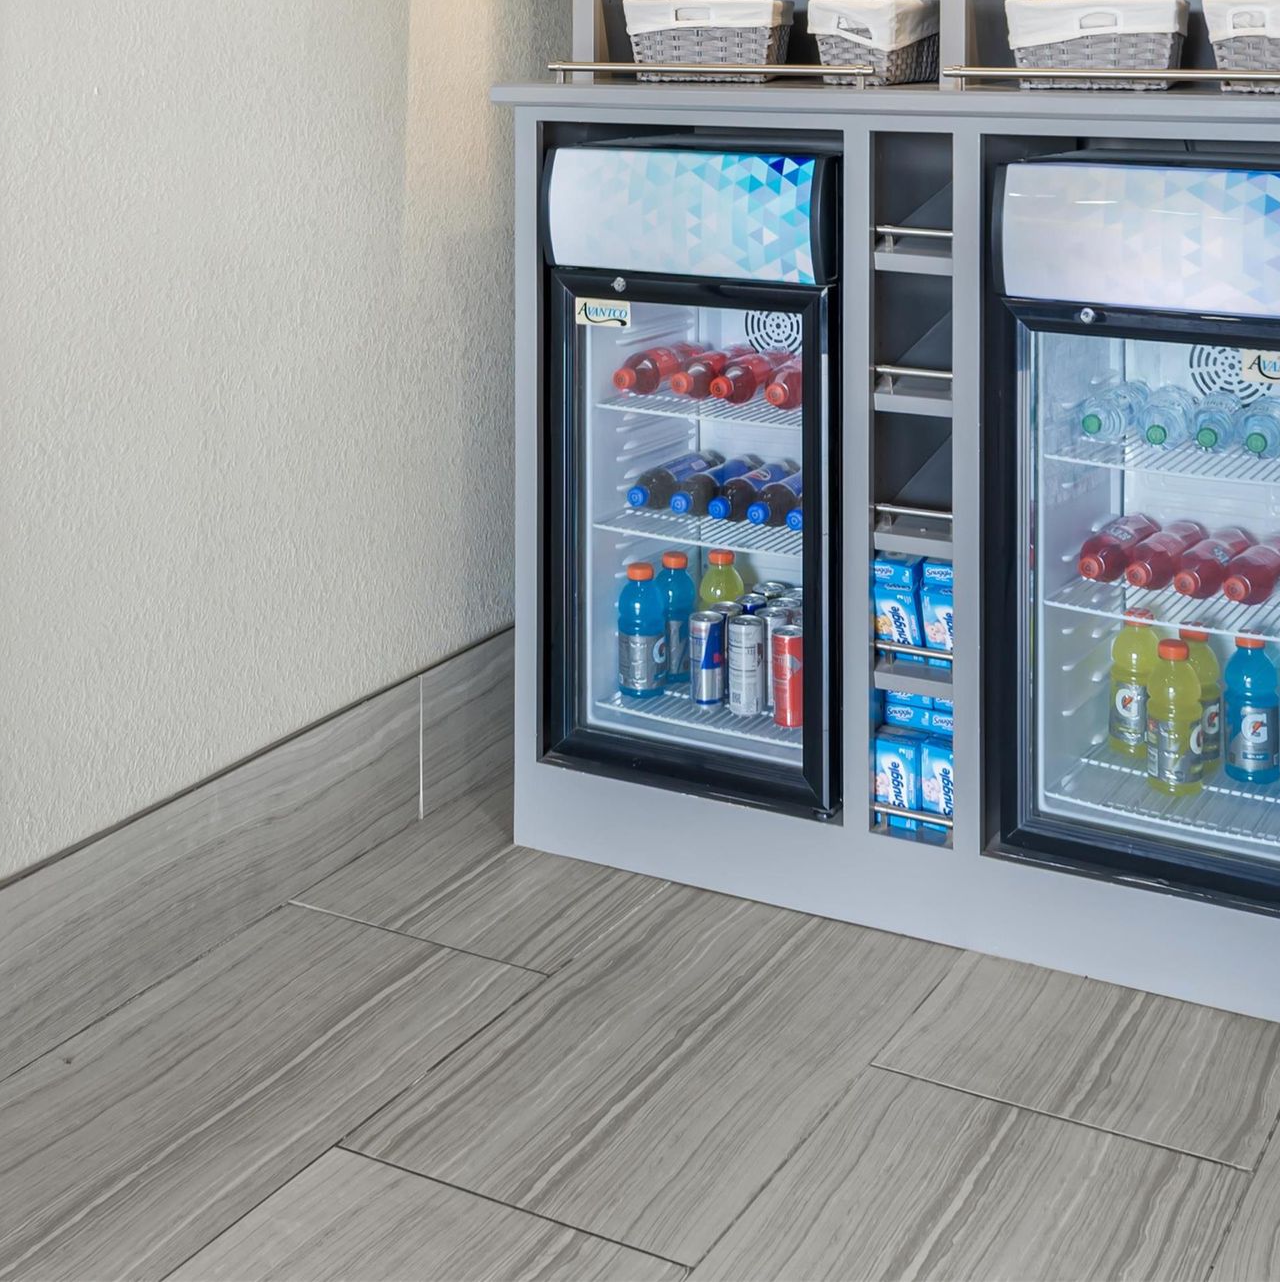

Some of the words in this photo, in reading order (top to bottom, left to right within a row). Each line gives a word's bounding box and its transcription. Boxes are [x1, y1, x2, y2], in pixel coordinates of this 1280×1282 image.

[577, 302, 628, 321] AVANTCO
[875, 566, 892, 575] uggle
[887, 706, 912, 717] Snuggle
[933, 715, 953, 726] Snugg
[1241, 713, 1268, 744] G
[887, 761, 906, 808] Snuggle
[938, 767, 953, 817] Snuggle
